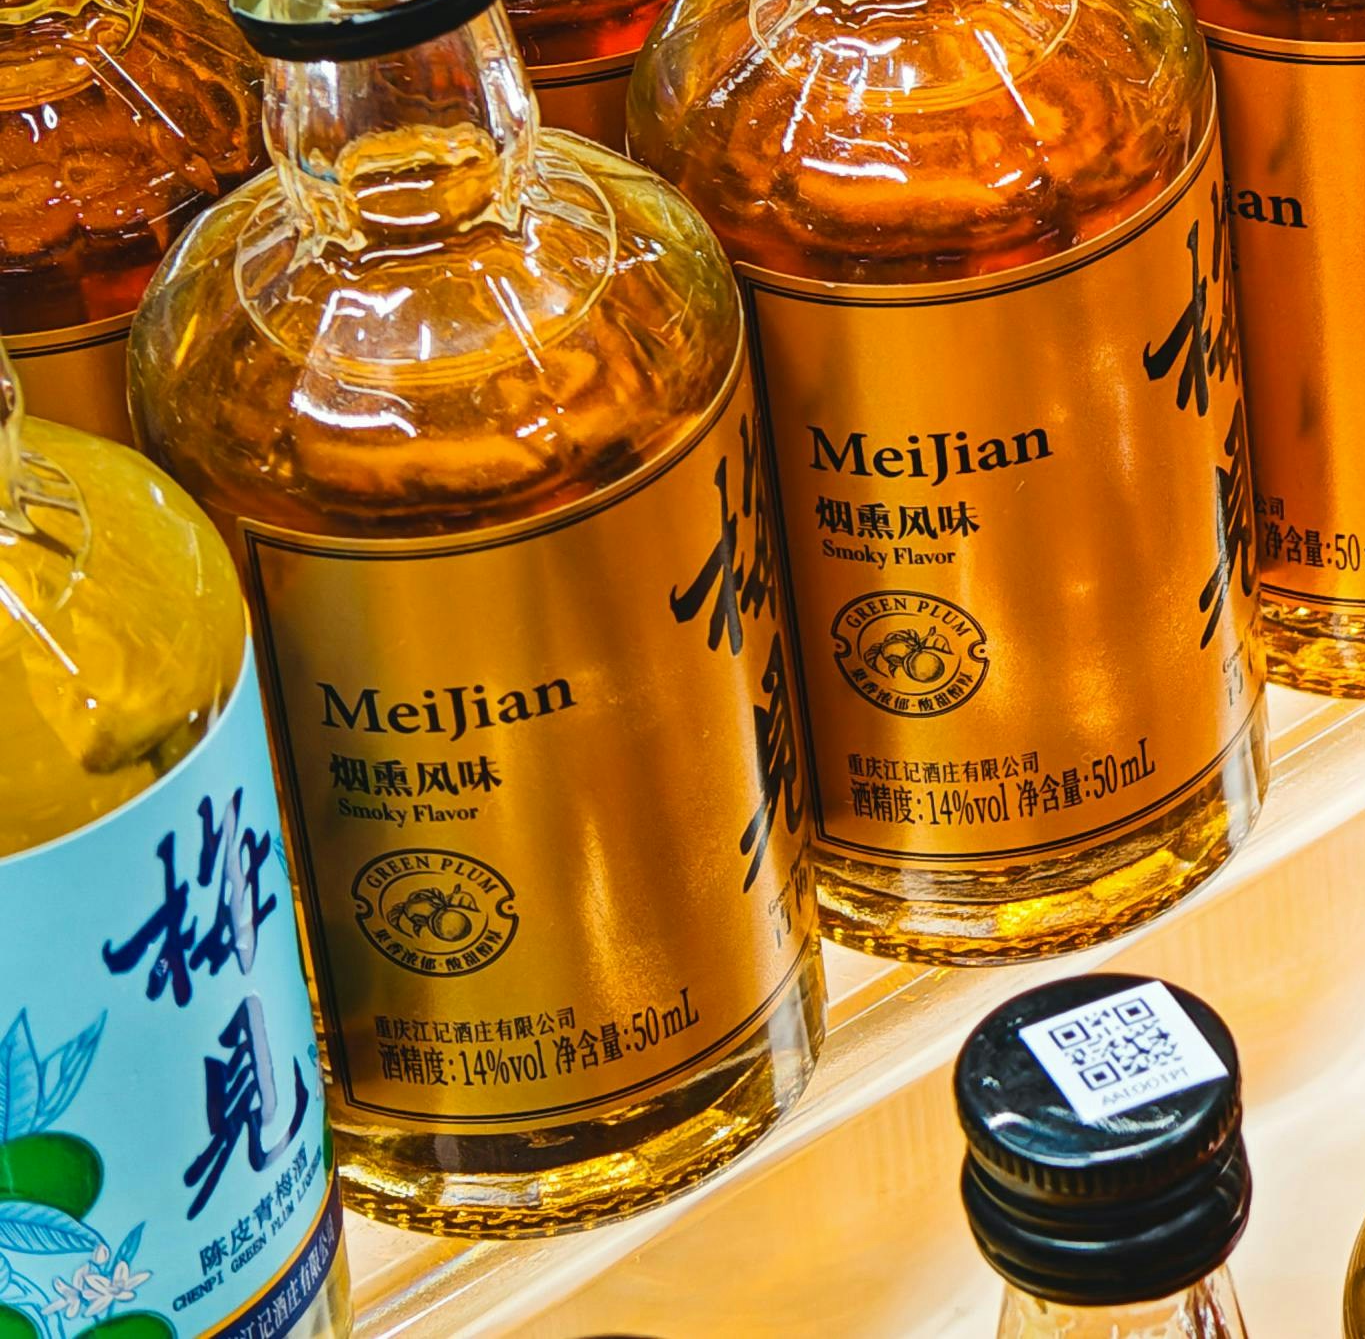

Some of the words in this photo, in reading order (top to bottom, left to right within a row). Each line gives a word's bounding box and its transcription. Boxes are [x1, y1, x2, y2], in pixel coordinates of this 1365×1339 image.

[806, 425, 1053, 486] MeiJian
[816, 496, 980, 540] 烟熏风味
[822, 539, 888, 570] Smoky
[893, 547, 956, 565] Flavor
[845, 597, 907, 628] GREEN
[917, 599, 973, 637] PLUM
[316, 677, 578, 742] MeiJian
[329, 752, 502, 797] 烟熏风味
[848, 751, 1040, 784] 重庆江记酒庄有限公司
[338, 797, 407, 828] Smoky
[412, 803, 479, 823] Flavor
[366, 855, 431, 889] GREEN
[440, 857, 499, 894] PLUM
[374, 1006, 577, 1044] 重庆江记酒庄有限公司
[172, 1270, 225, 1313] CHENPI
